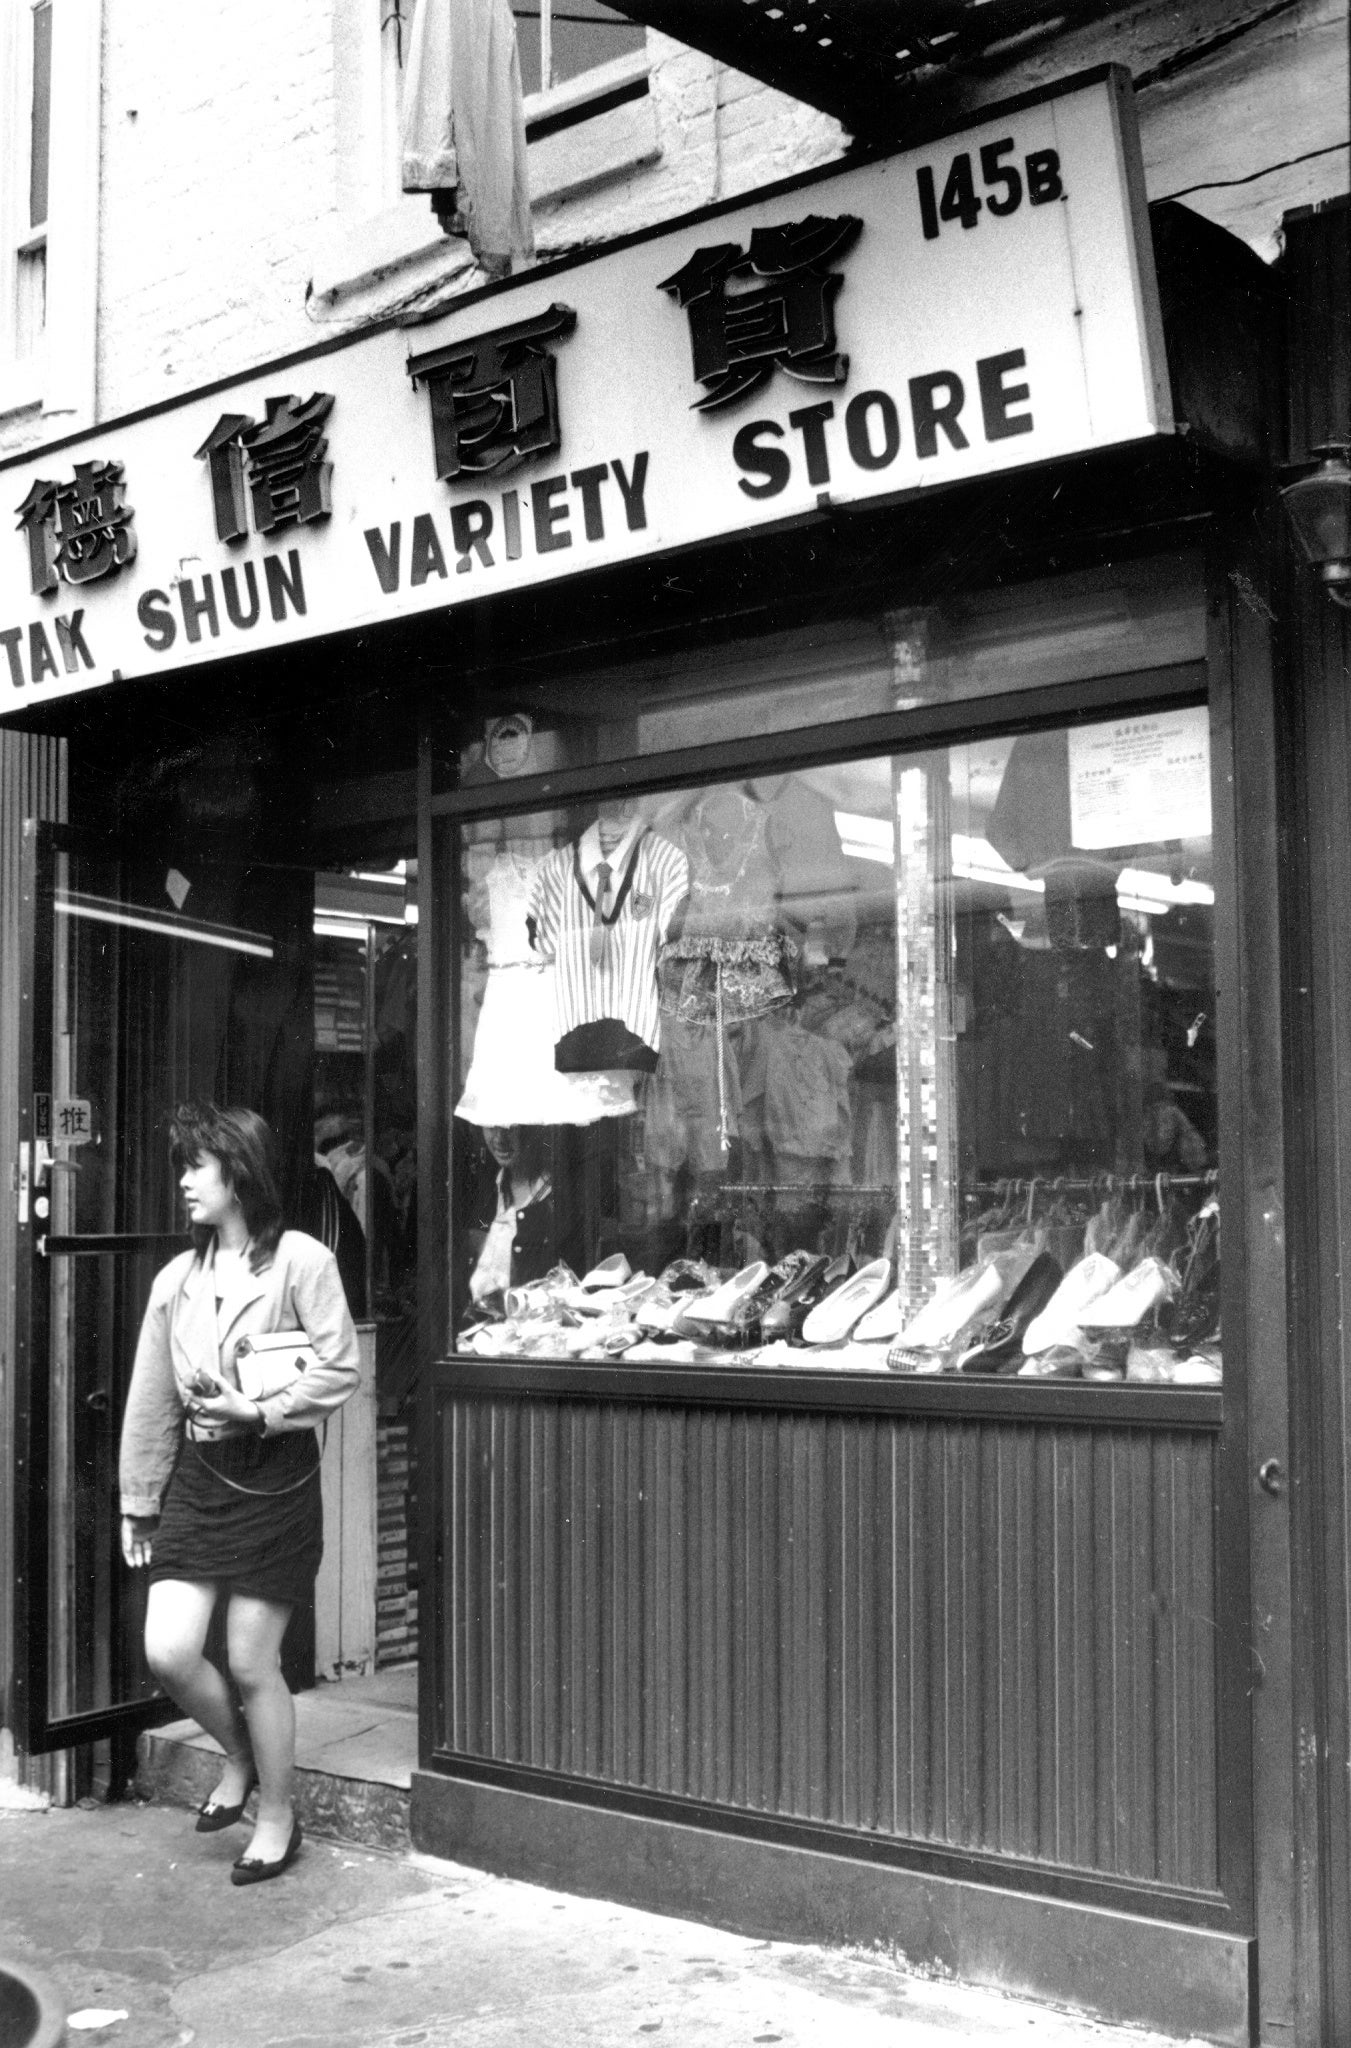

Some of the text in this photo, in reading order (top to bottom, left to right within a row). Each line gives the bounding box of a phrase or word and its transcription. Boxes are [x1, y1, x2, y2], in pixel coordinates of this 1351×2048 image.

[915, 137, 1064, 240] 145B
[0, 347, 1035, 687] TAK SHUN VARIETY STORE
[59, 1107, 89, 1136] 推
